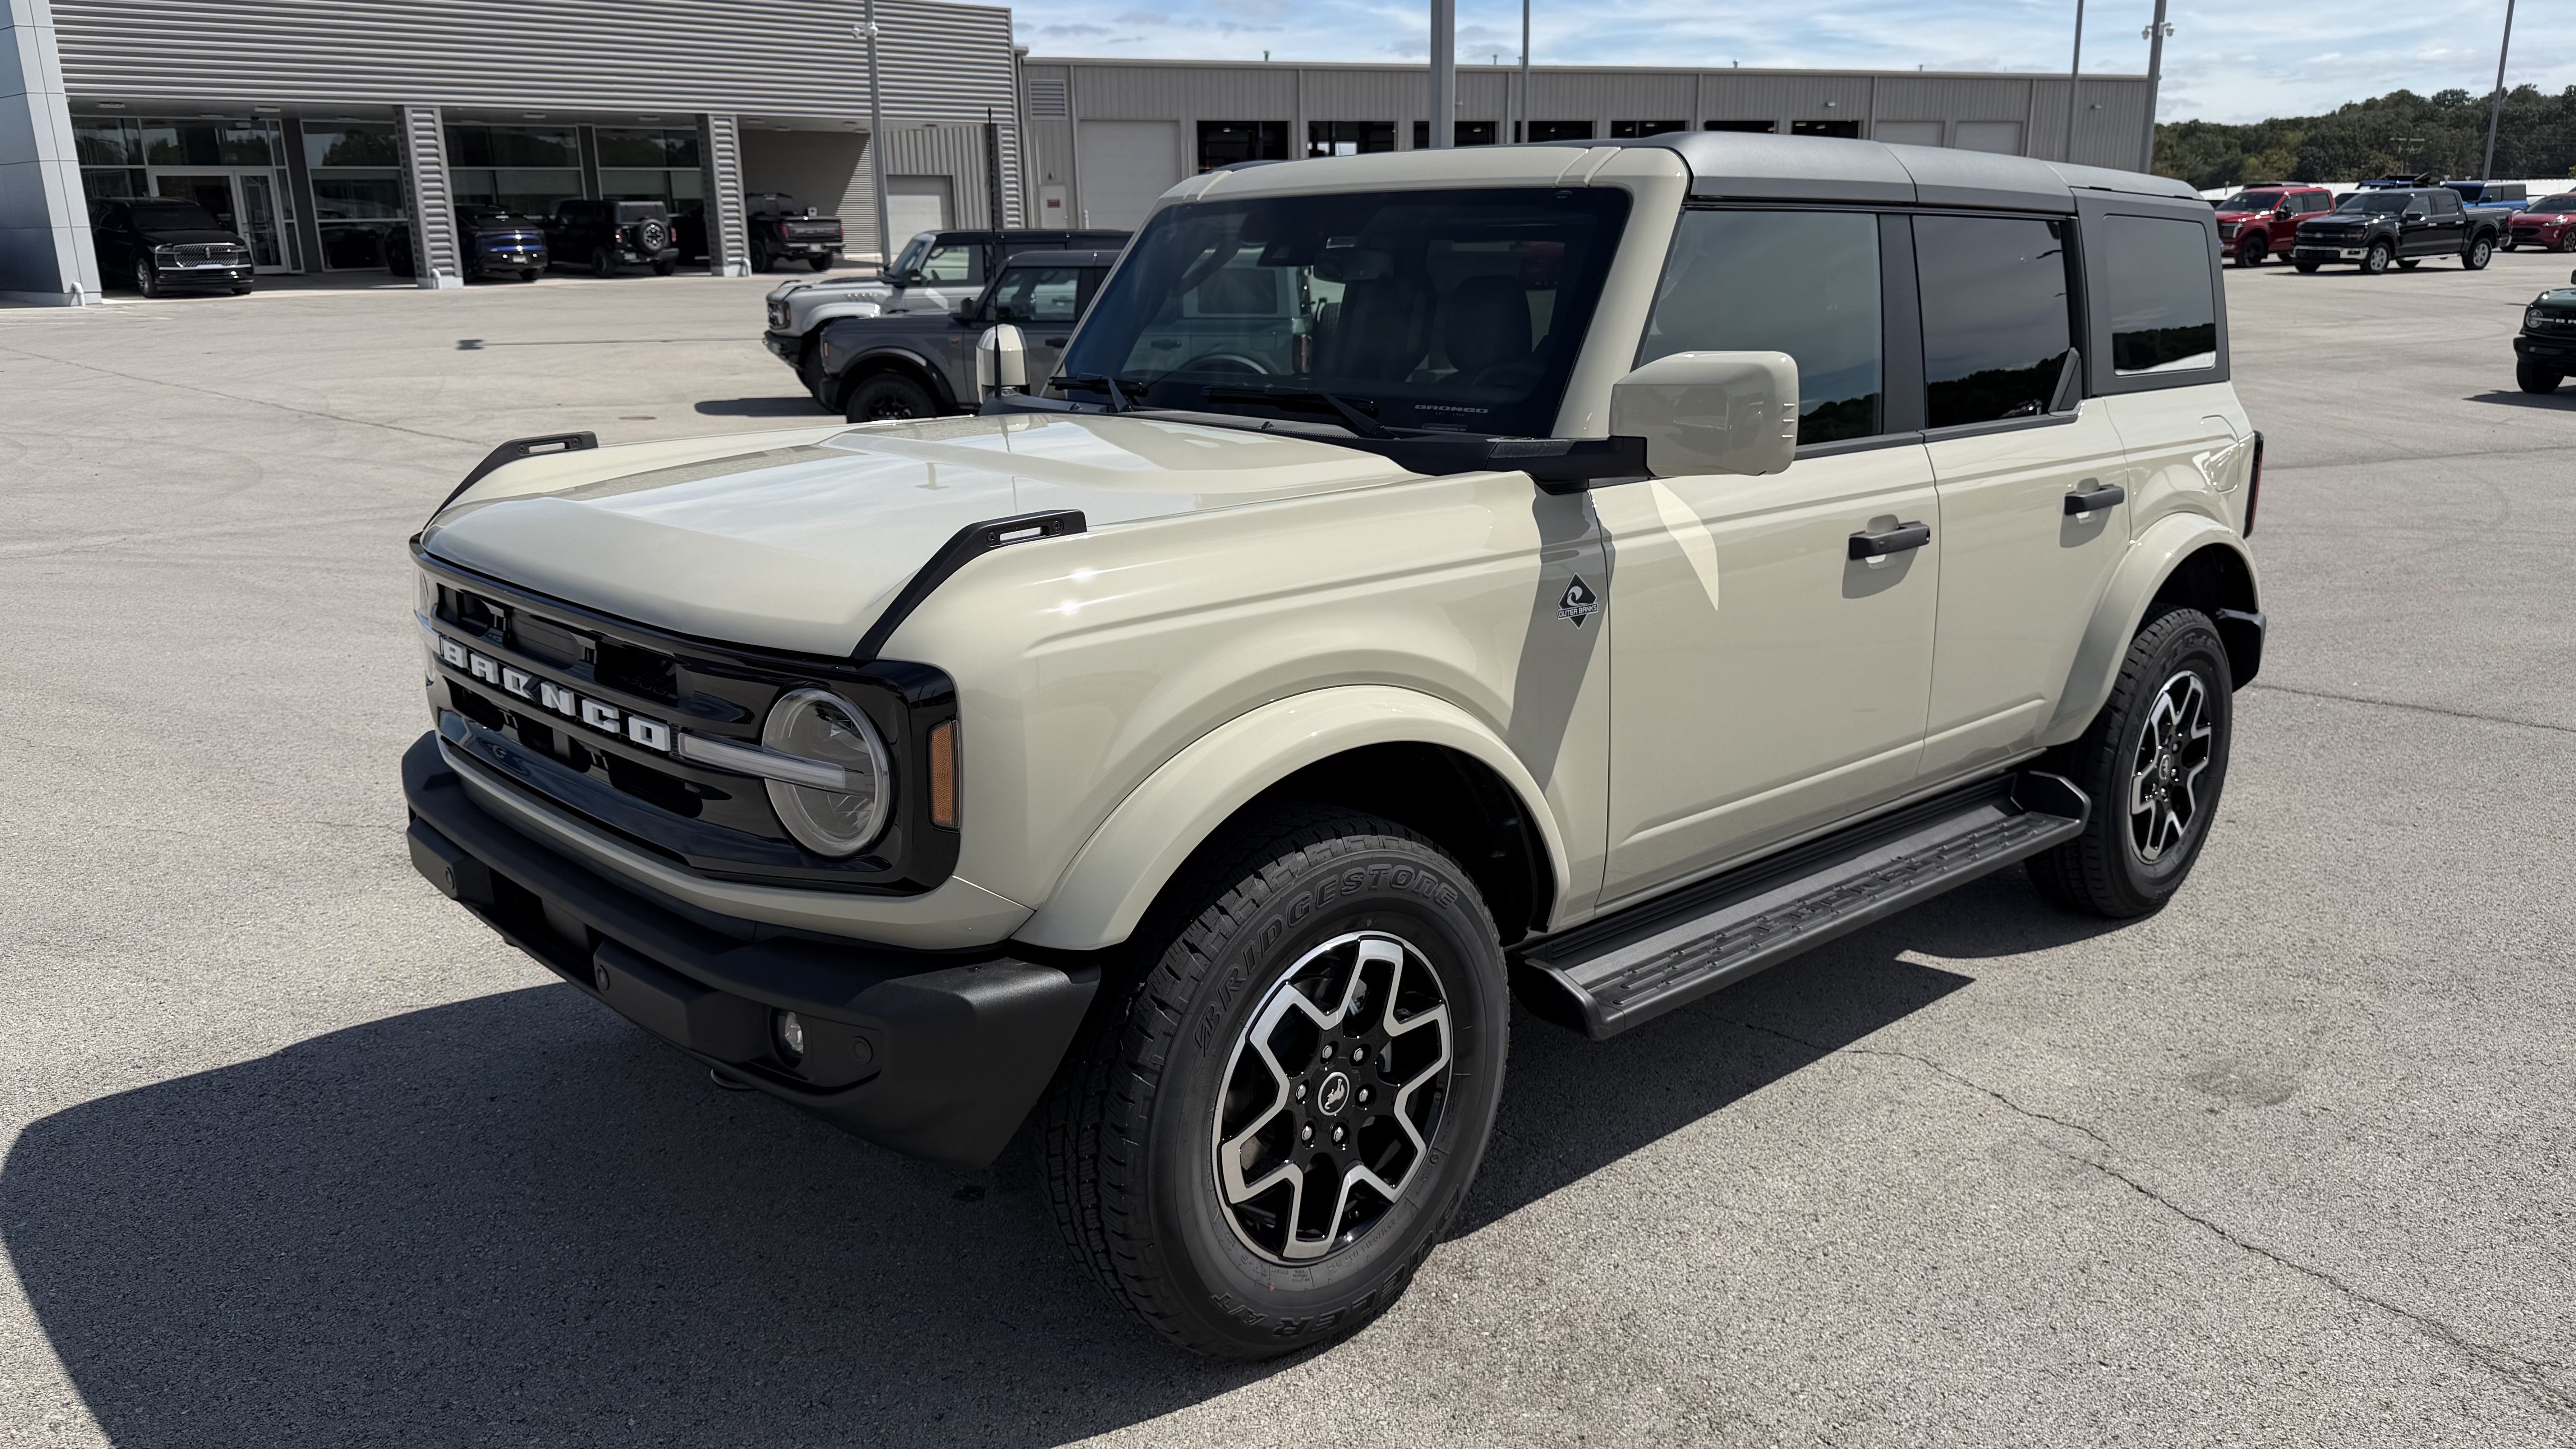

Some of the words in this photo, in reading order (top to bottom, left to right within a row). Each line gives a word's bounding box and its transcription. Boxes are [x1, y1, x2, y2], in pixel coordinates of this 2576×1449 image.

[1559, 608, 1578, 617] OUTER
[1578, 604, 1597, 614] BANKS
[443, 637, 671, 752] BRONCO
[1192, 863, 1458, 1058] BRIDGESTONE
[1208, 1291, 1269, 1326] A/T
